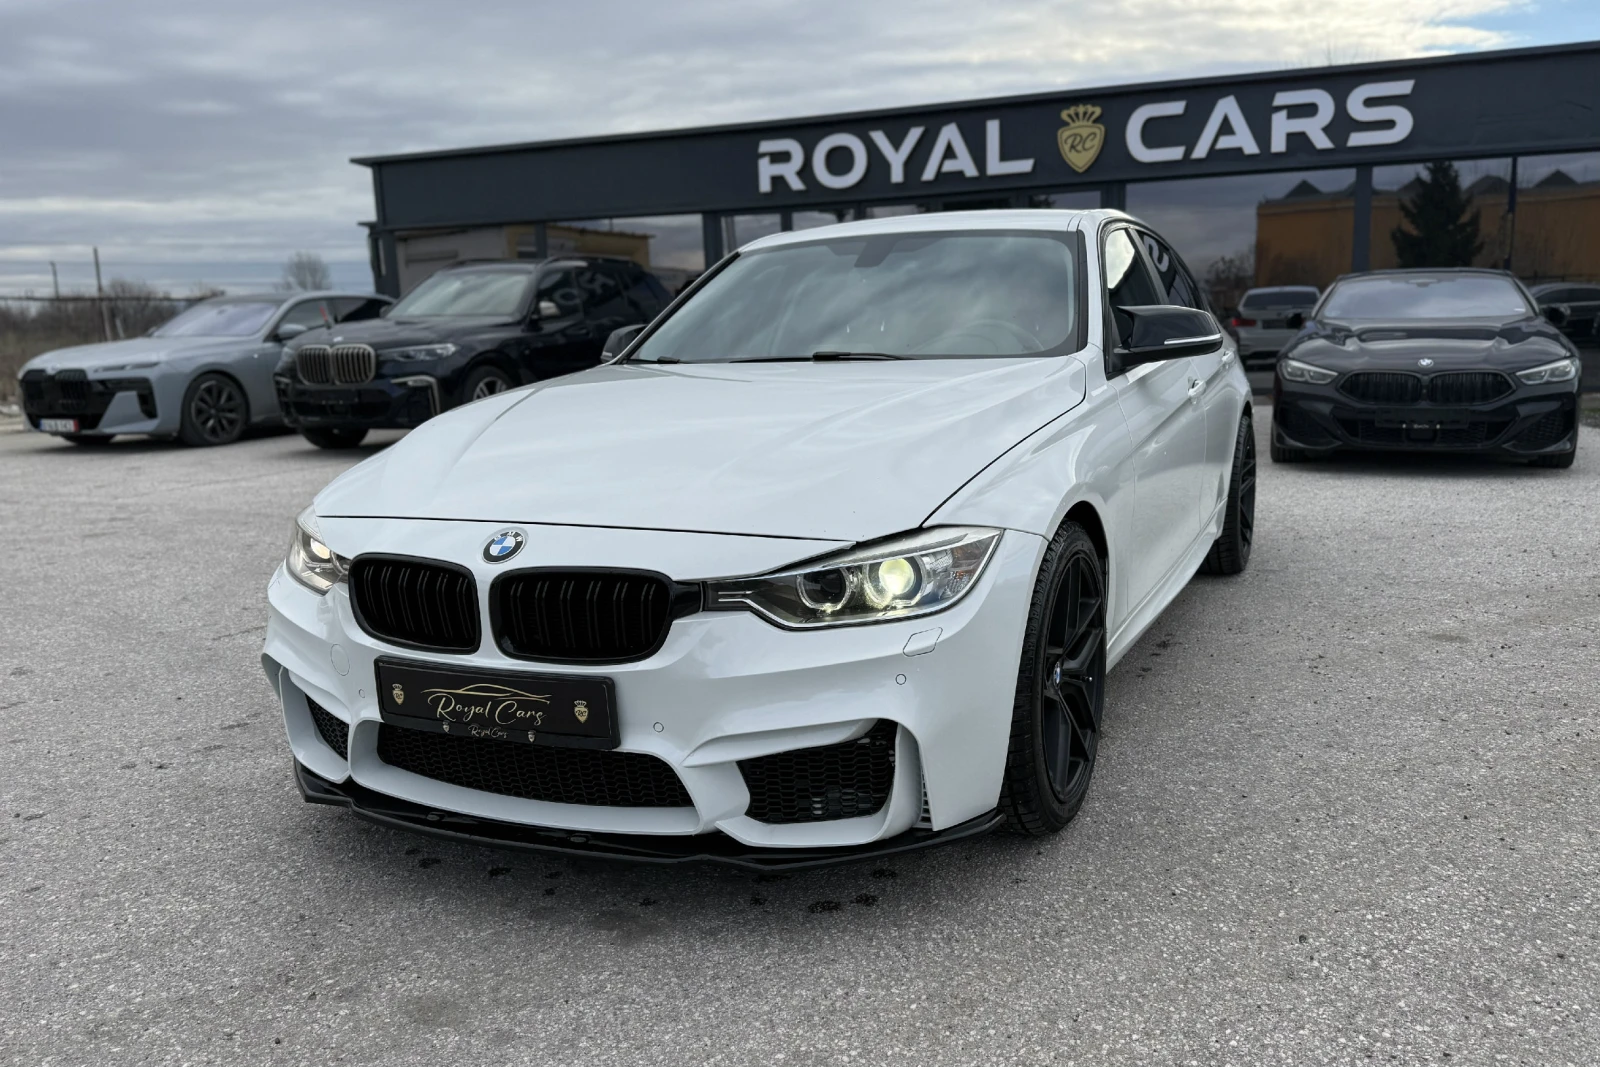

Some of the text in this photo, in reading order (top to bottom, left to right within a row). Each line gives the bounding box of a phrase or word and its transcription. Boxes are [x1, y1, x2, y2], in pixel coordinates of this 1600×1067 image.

[757, 79, 1416, 194] ROYAL CARS
[1063, 132, 1097, 154] RC
[427, 692, 547, 726] Royal Cars
